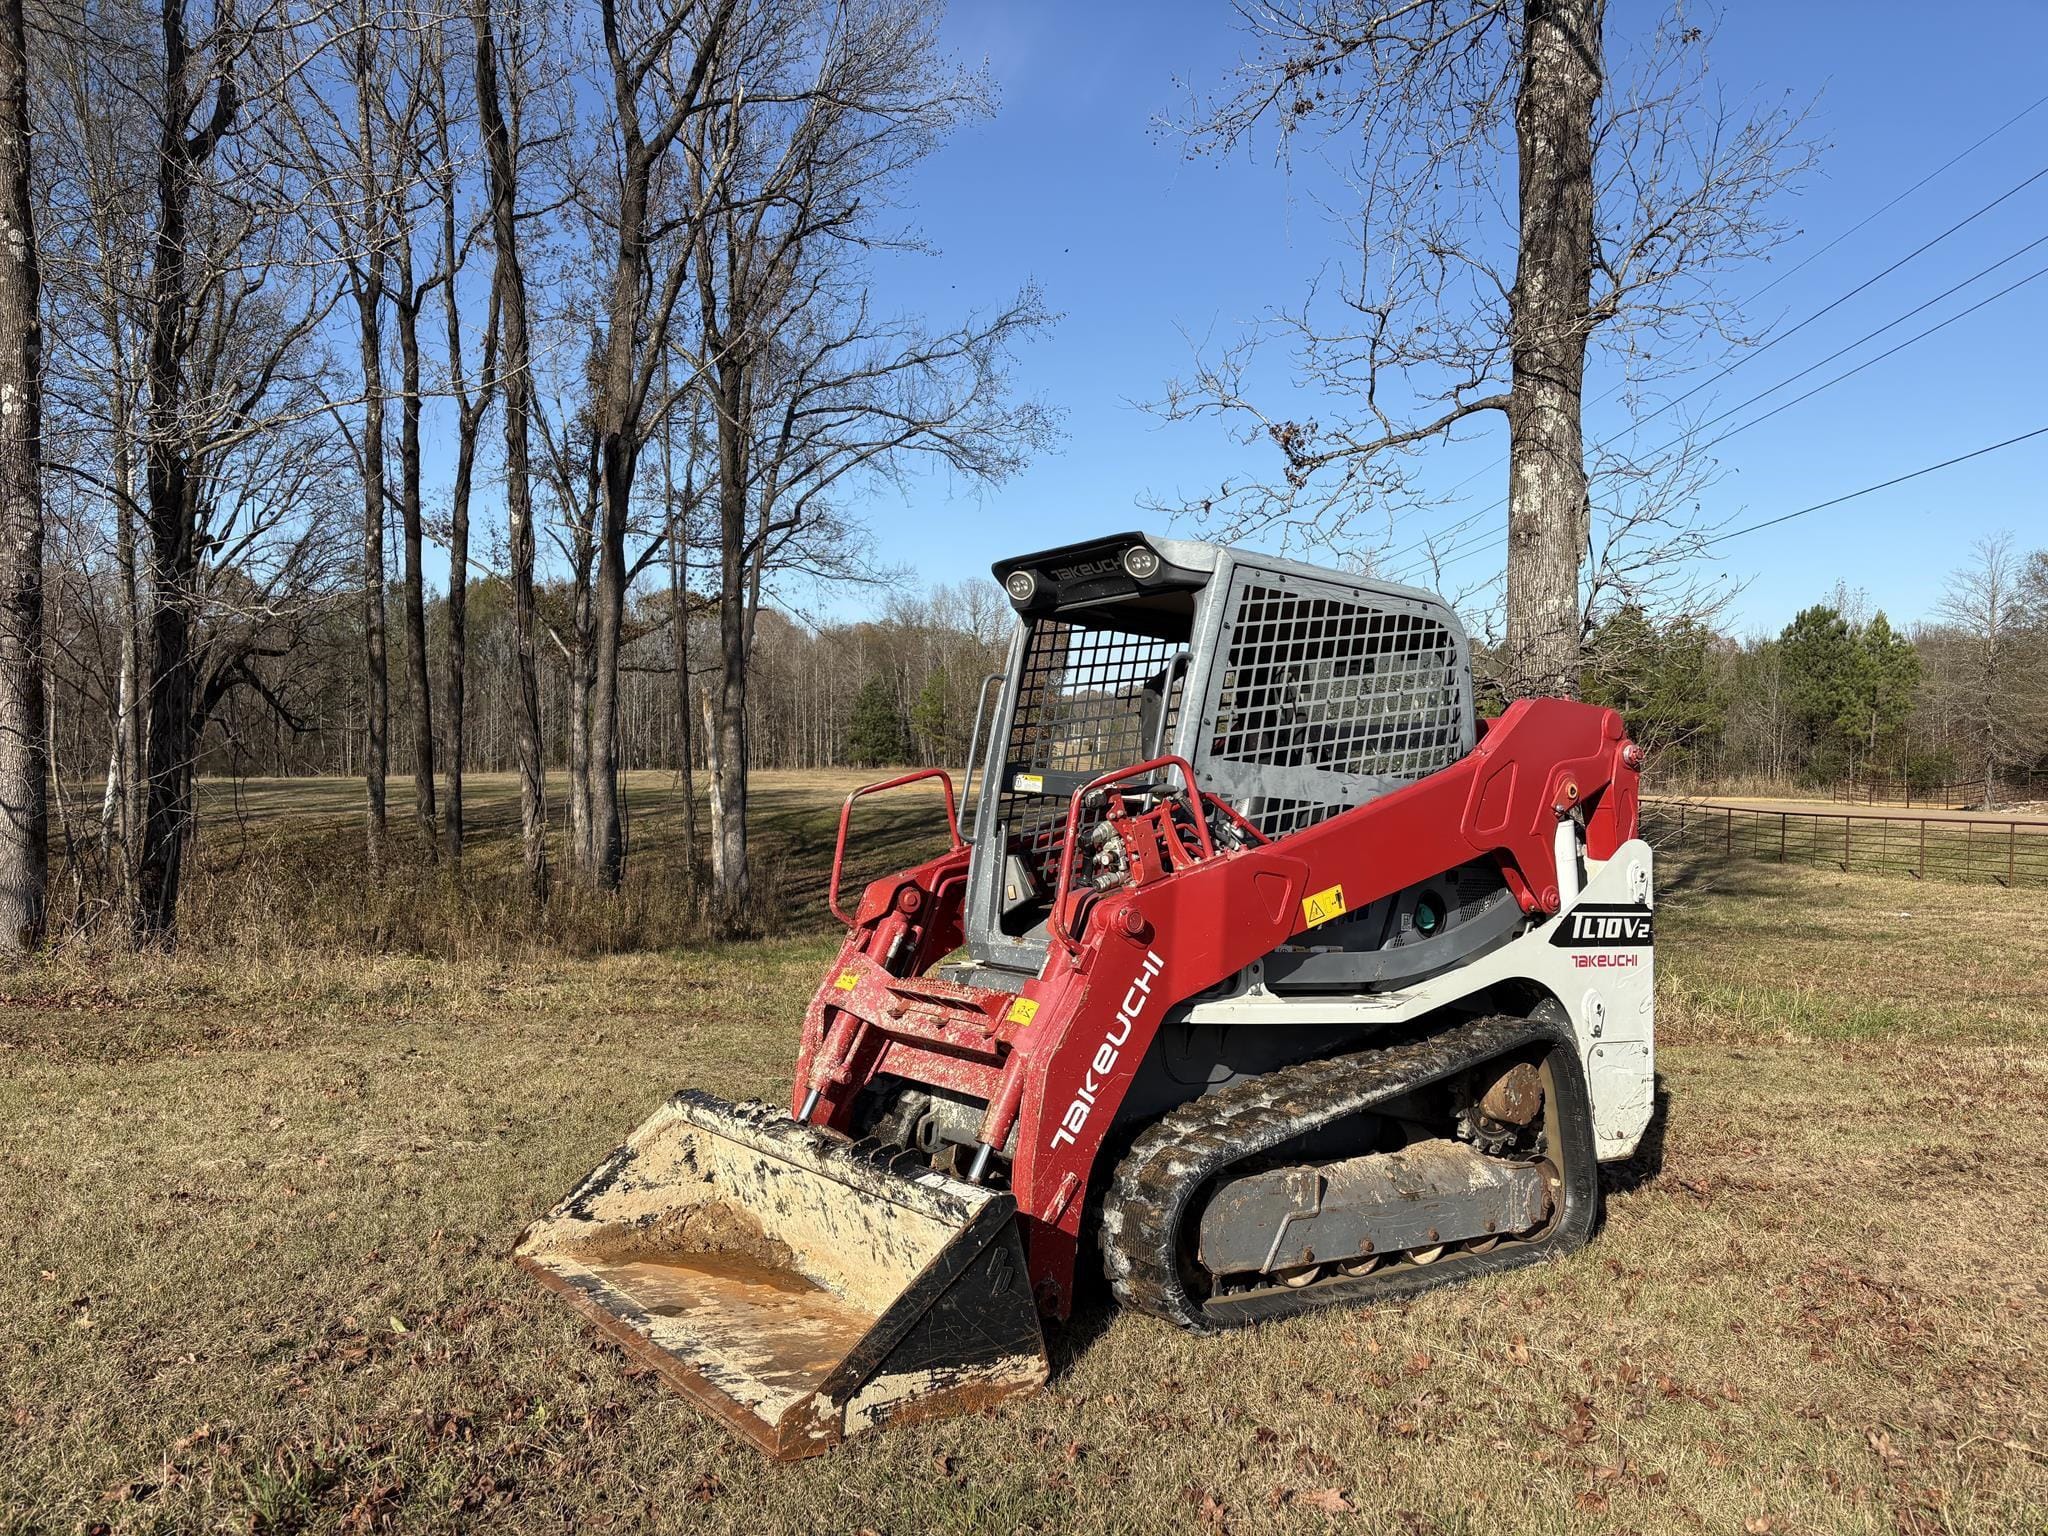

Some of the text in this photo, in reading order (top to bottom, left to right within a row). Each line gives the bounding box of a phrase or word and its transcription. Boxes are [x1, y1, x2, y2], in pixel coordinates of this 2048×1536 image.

[1050, 557, 1125, 580] TAKEUCH
[1571, 954, 1638, 968] TAKEUCHI
[1050, 950, 1165, 1149] TAKEUCHI
